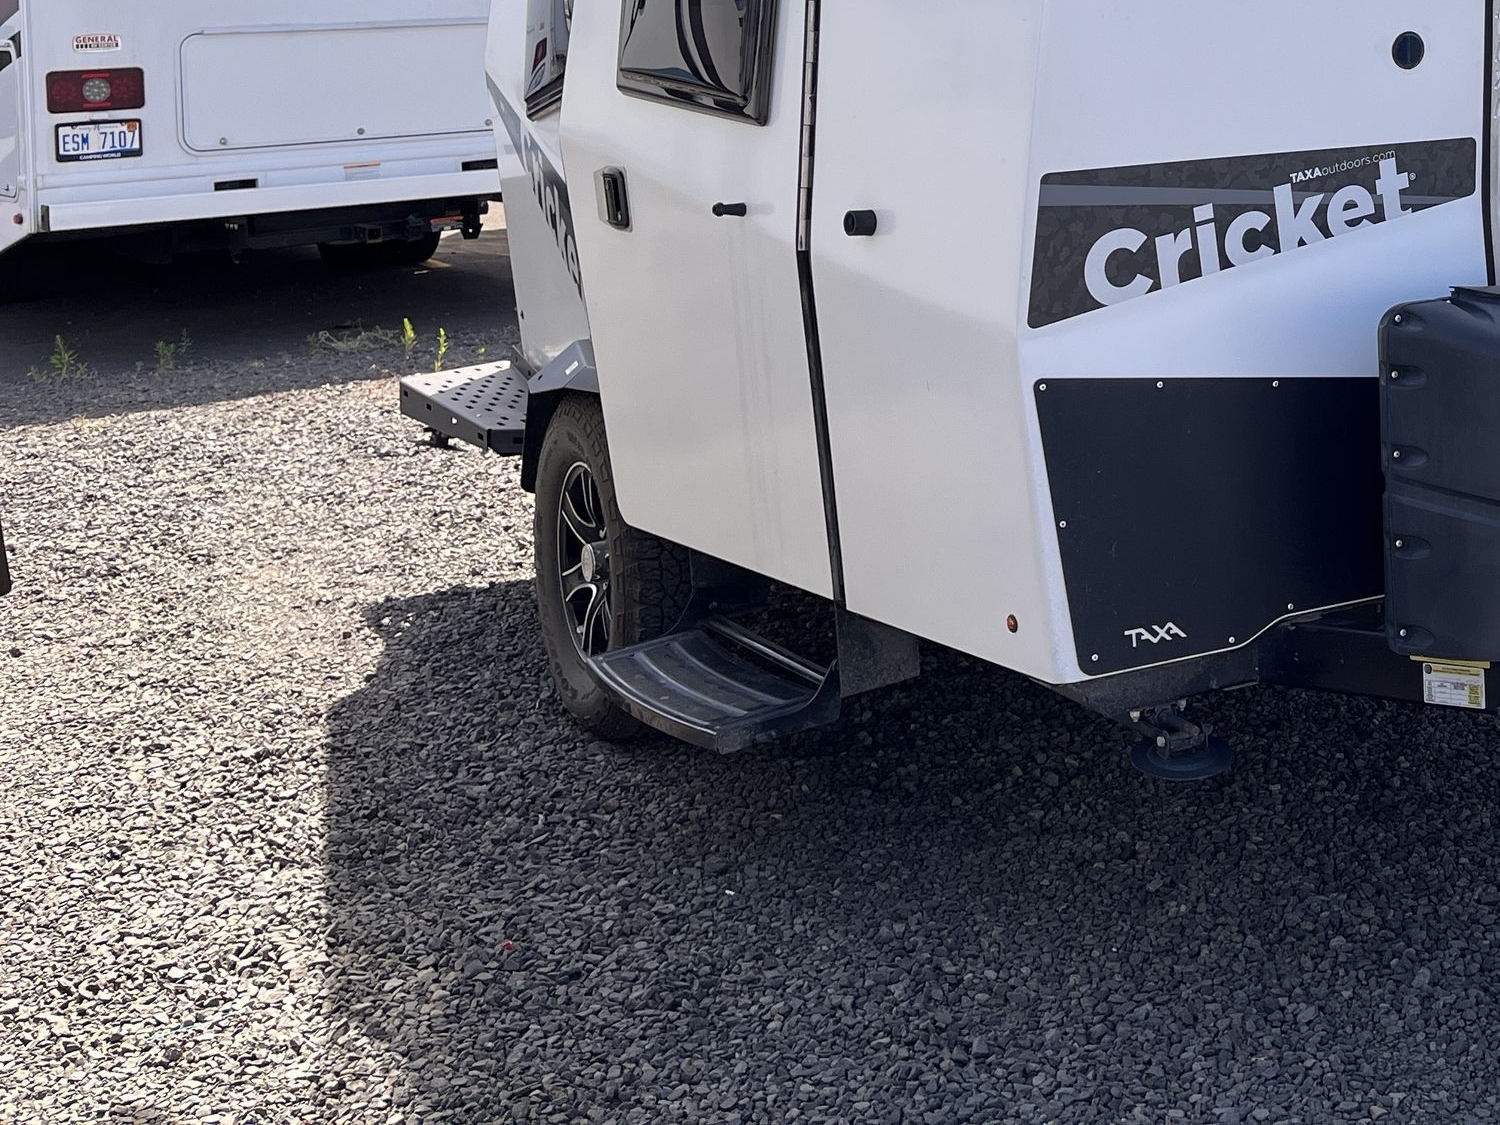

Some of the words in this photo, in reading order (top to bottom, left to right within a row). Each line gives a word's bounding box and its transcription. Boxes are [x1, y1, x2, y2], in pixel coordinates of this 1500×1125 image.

[75, 35, 119, 44] GENERAL
[62, 133, 89, 153] ESM
[99, 130, 136, 150] 7107
[1289, 150, 1396, 183] TAXAoutdoors.com
[1084, 157, 1412, 306] Cricket
[1124, 621, 1187, 647] TAXA
